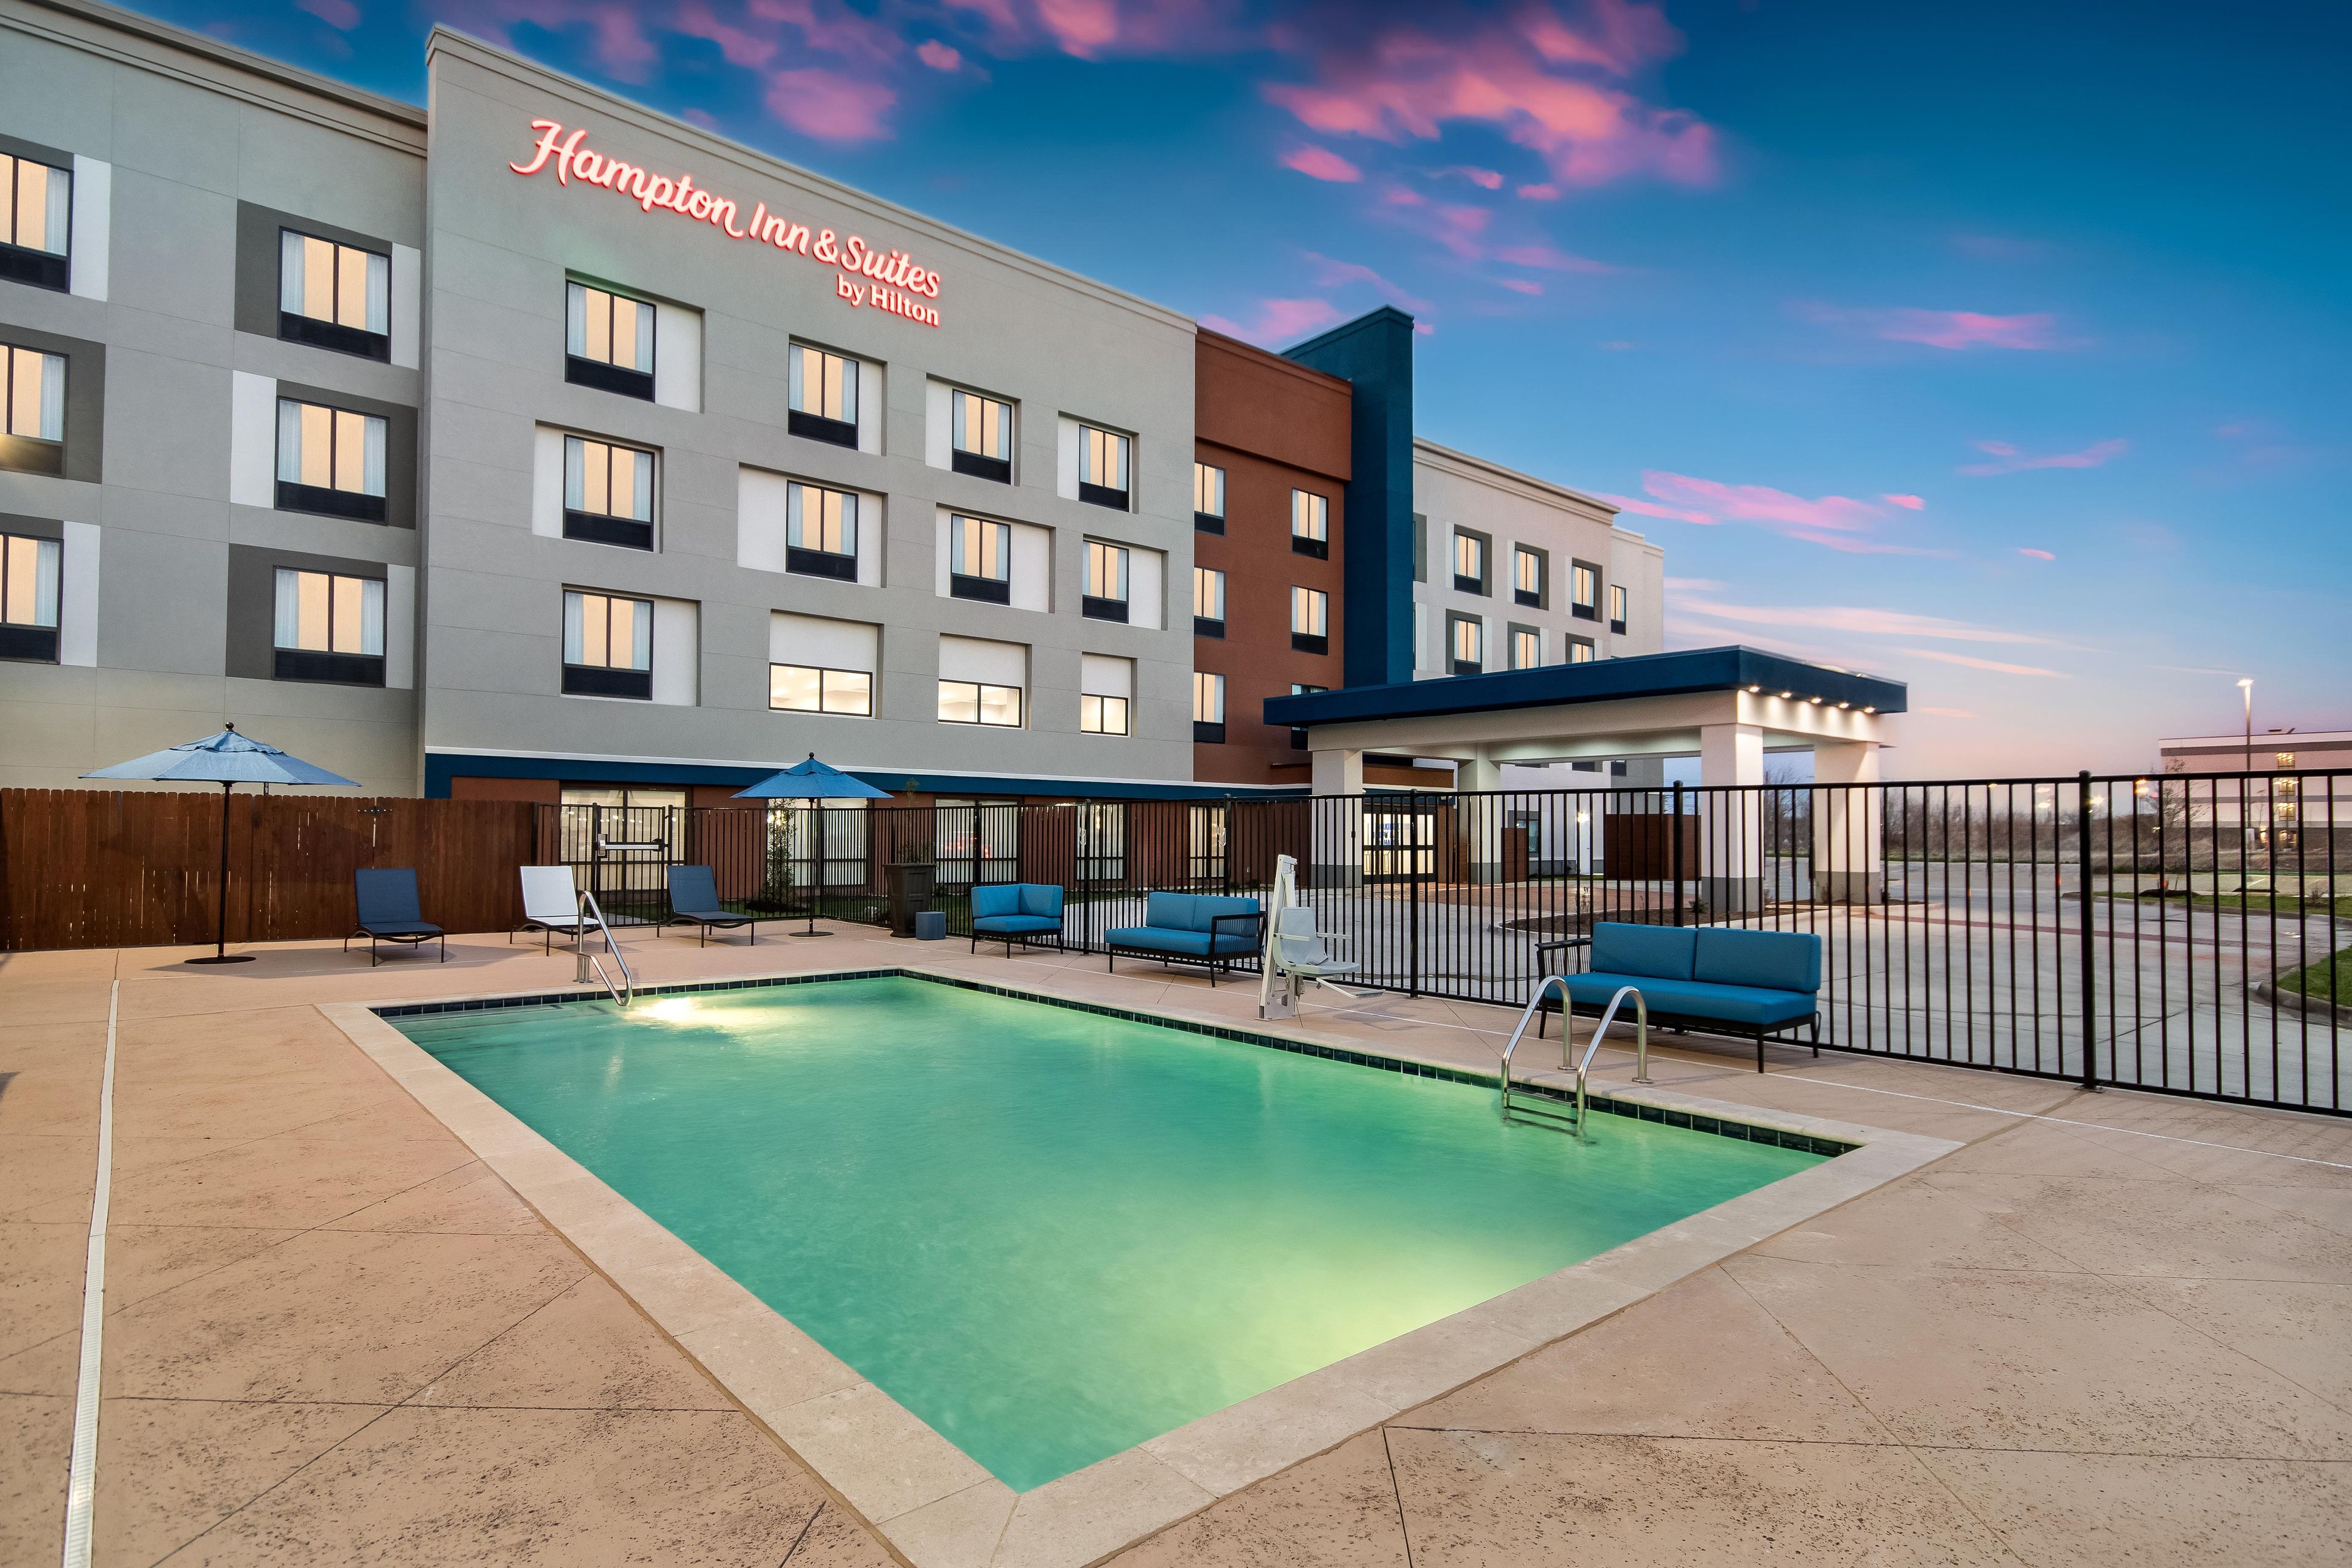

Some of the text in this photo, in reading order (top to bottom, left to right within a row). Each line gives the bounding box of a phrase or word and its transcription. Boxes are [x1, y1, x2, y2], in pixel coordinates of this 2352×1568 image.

[510, 119, 744, 238] Hampton
[748, 202, 810, 255] Inn
[841, 236, 940, 298] Suites
[837, 273, 939, 326] by Hilton
